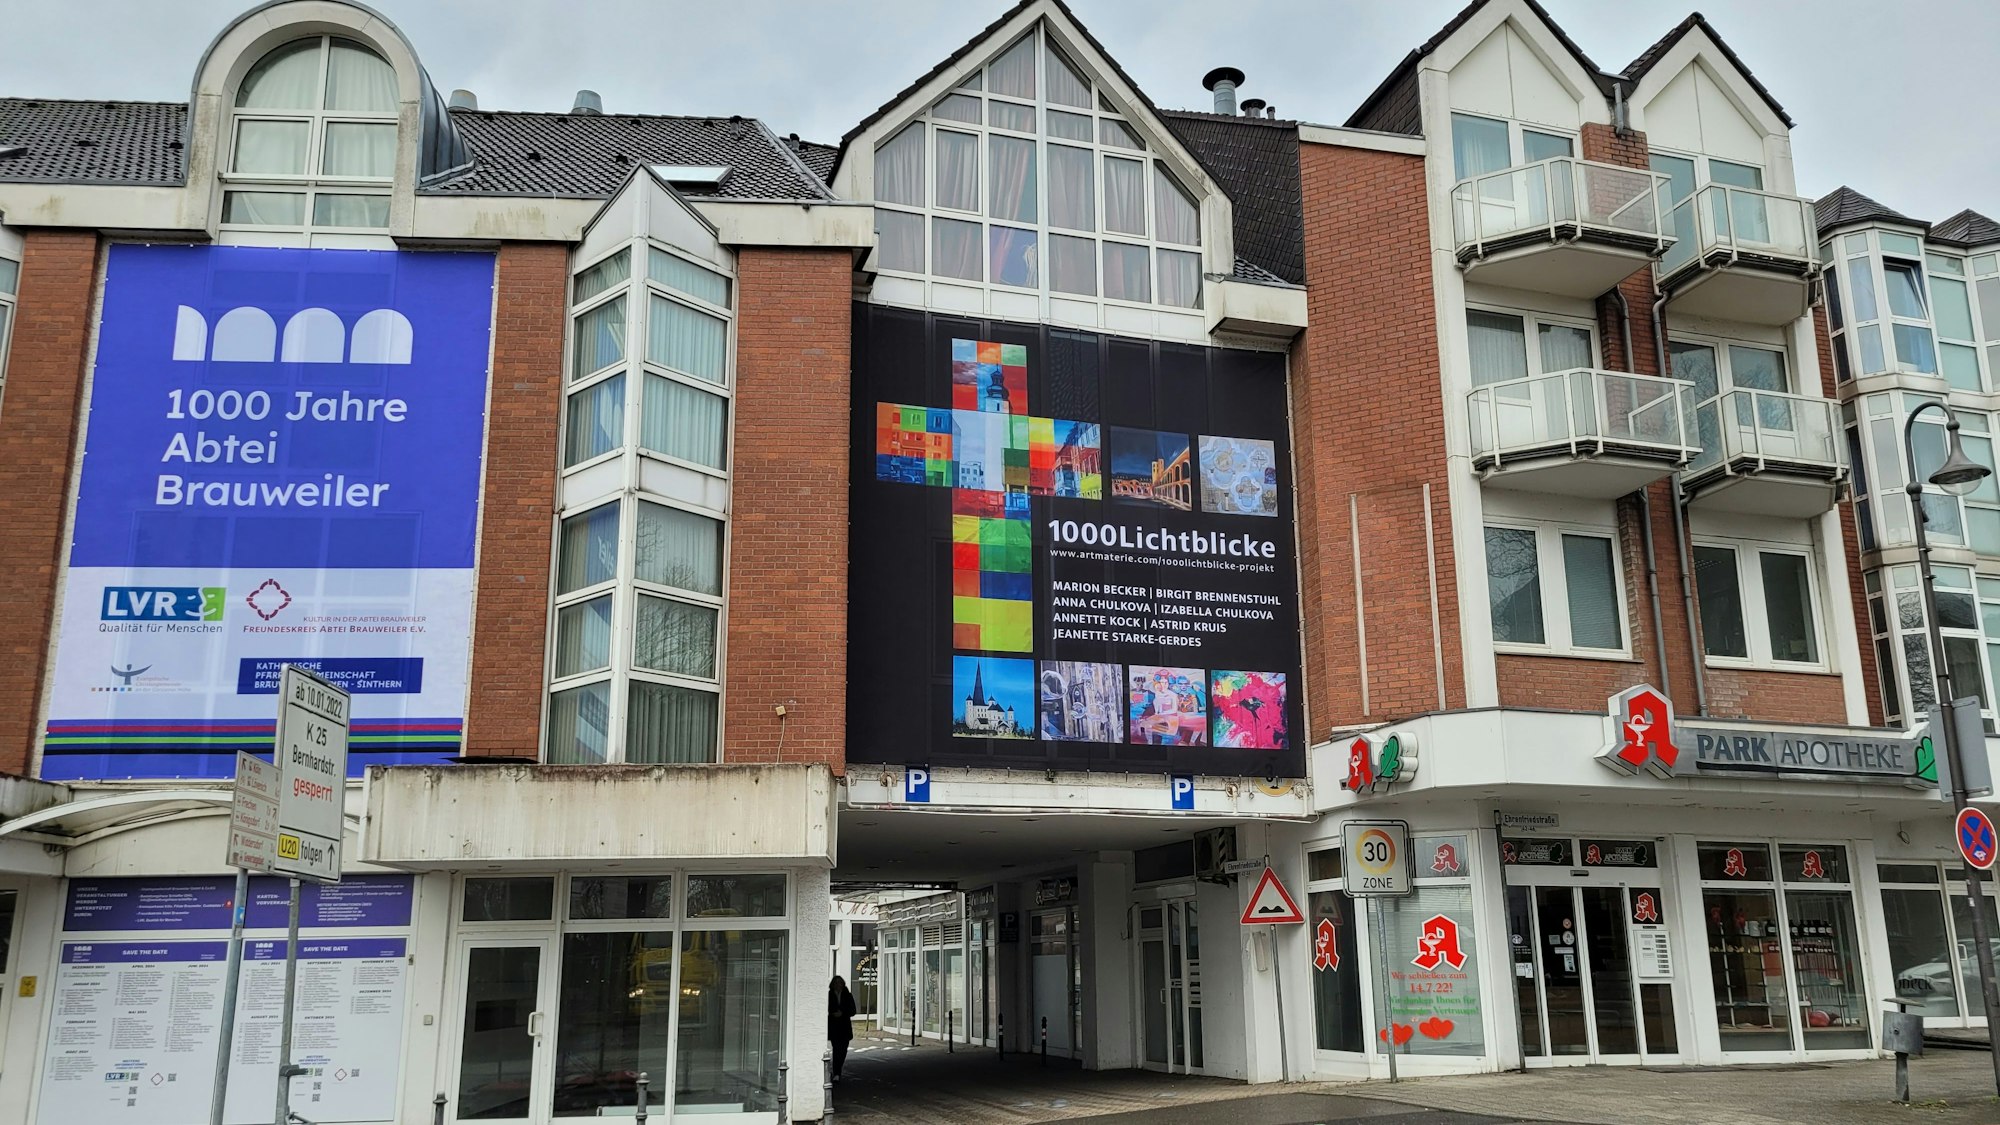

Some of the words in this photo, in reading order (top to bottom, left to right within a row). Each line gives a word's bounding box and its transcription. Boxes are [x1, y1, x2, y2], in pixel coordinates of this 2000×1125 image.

[166, 389, 271, 421] 1000
[285, 390, 408, 422] Jahre
[161, 430, 279, 464] Abtei
[156, 474, 391, 507] Brauweiler
[1048, 519, 1277, 559] 1000Lichtblicke
[1049, 549, 1275, 573] www.artmaterie.com/1000lichtblicke-projekt
[107, 591, 178, 616] LVR
[1053, 581, 1100, 594] MARION
[1103, 584, 1147, 597] BECKER
[1156, 587, 1193, 600] BIRGIT
[1195, 591, 1282, 606] BRENNENSTUHL
[1053, 597, 1087, 608] ANNA
[1090, 599, 1151, 613] CHULKOVA
[1161, 604, 1213, 617] IZABELLA
[1215, 607, 1274, 620] CHULKOVA
[99, 622, 142, 633] Qualität
[146, 622, 163, 633] für
[166, 622, 223, 633] Menschen
[1053, 612, 1107, 626] ANNETTE
[1109, 616, 1141, 628] KOCK
[1150, 619, 1191, 632] ASTRID
[1194, 622, 1227, 633] KRUIS
[1053, 628, 1109, 642] JEANETTE
[1112, 632, 1202, 648] STARKE-GERDES
[296, 682, 304, 701] ab
[308, 686, 342, 718] 10.01.2022
[306, 722, 314, 742] K
[316, 726, 328, 746] 25
[292, 744, 336, 778] Bernhardstr.
[1696, 734, 1771, 763] PARK
[1780, 738, 1904, 769] APOTHEKE
[294, 778, 333, 802] gesperrt
[908, 769, 928, 794] P
[1174, 778, 1192, 802] P
[1504, 814, 1556, 824] Ehrenfriedstraße
[281, 838, 297, 856] U20
[301, 840, 323, 866] folgen
[1364, 842, 1387, 862] 30
[1362, 878, 1394, 889] ZONE
[1410, 982, 1454, 993] 14.7.22!
